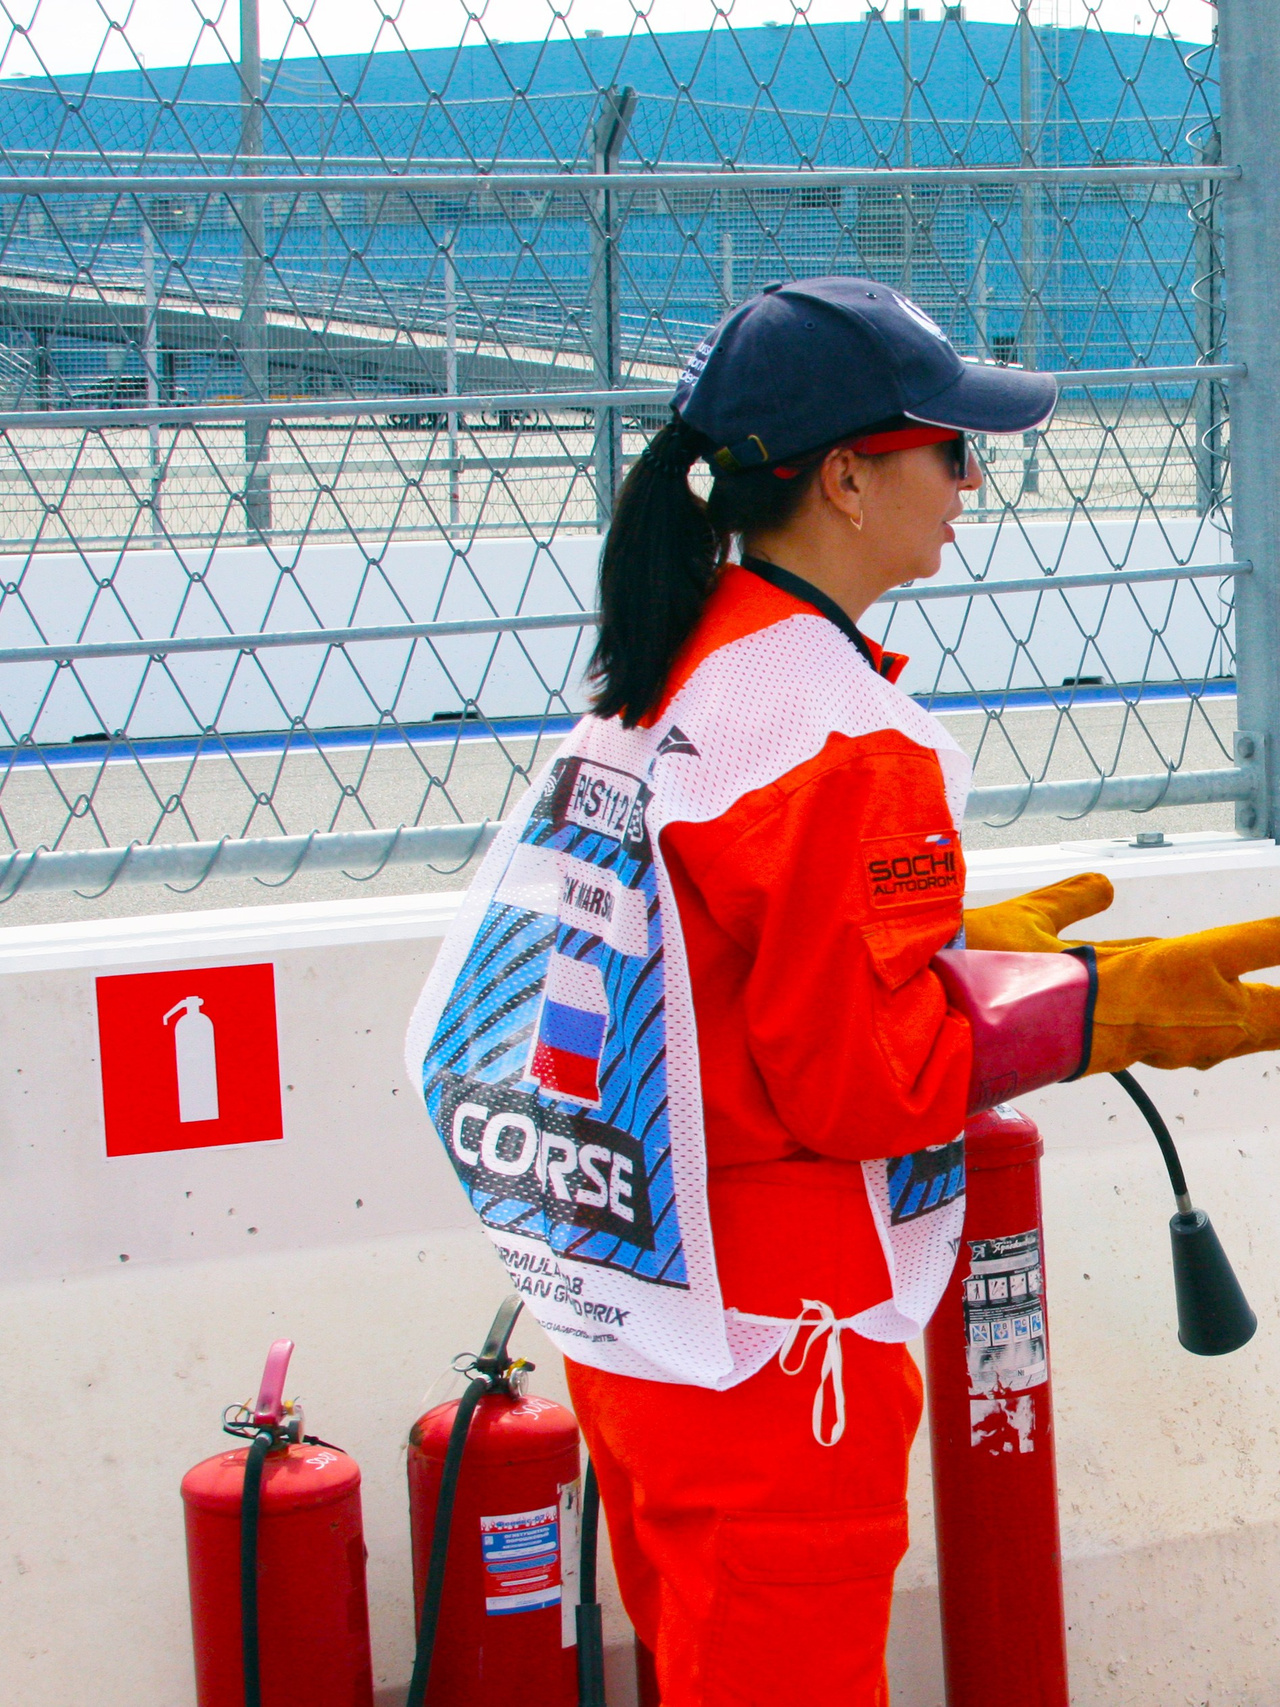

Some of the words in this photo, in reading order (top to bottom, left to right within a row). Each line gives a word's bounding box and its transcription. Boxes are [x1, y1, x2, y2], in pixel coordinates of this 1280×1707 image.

[868, 852, 955, 881] SOCHI
[873, 875, 957, 896] AUTODROM
[453, 1102, 635, 1223] CORSE
[583, 1301, 630, 1327] PRIX
